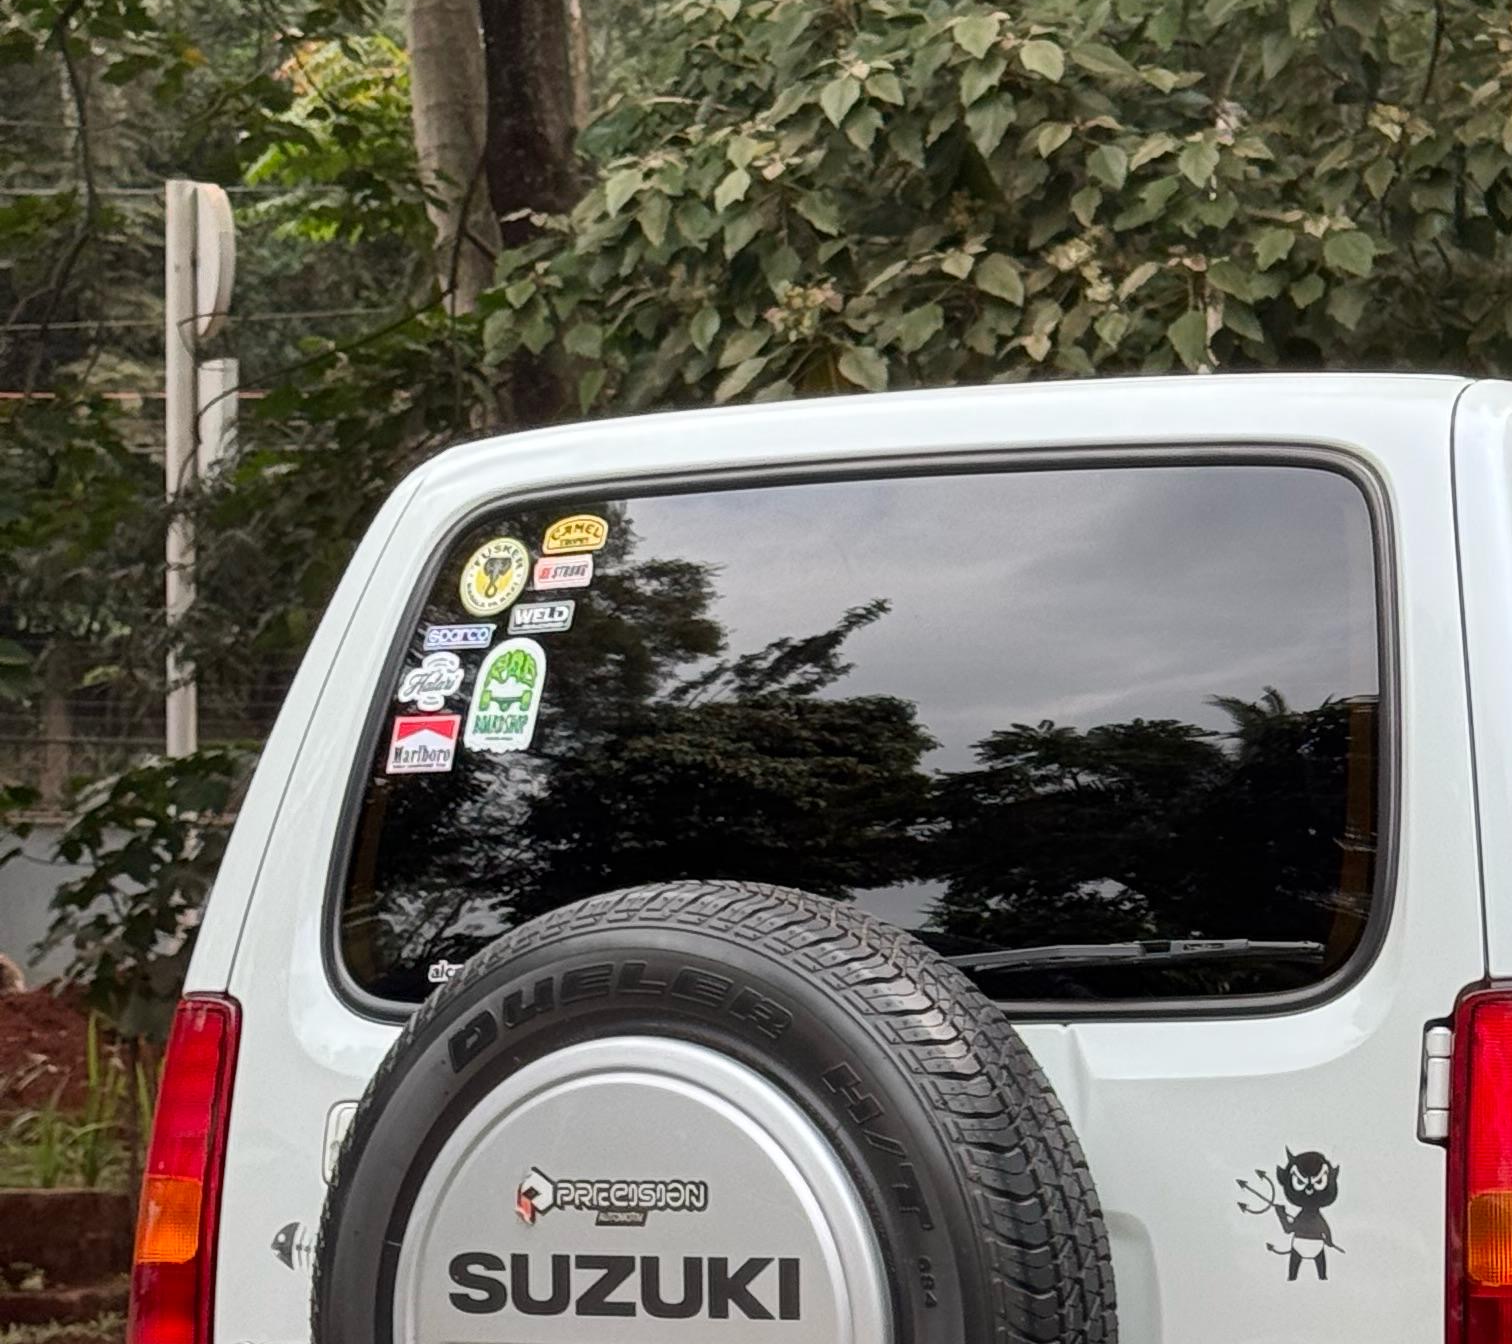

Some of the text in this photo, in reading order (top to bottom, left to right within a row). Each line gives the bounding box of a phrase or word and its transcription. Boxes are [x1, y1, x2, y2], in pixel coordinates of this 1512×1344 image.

[551, 523, 601, 541] CAMEL
[473, 545, 523, 570] TUSKER
[514, 606, 569, 625] WELD
[428, 628, 489, 643] sparco
[392, 744, 451, 764] Marlboro
[448, 961, 794, 1072] DUELER
[556, 1182, 706, 1208] PRECISION
[448, 1252, 801, 1320] SUZUKI
